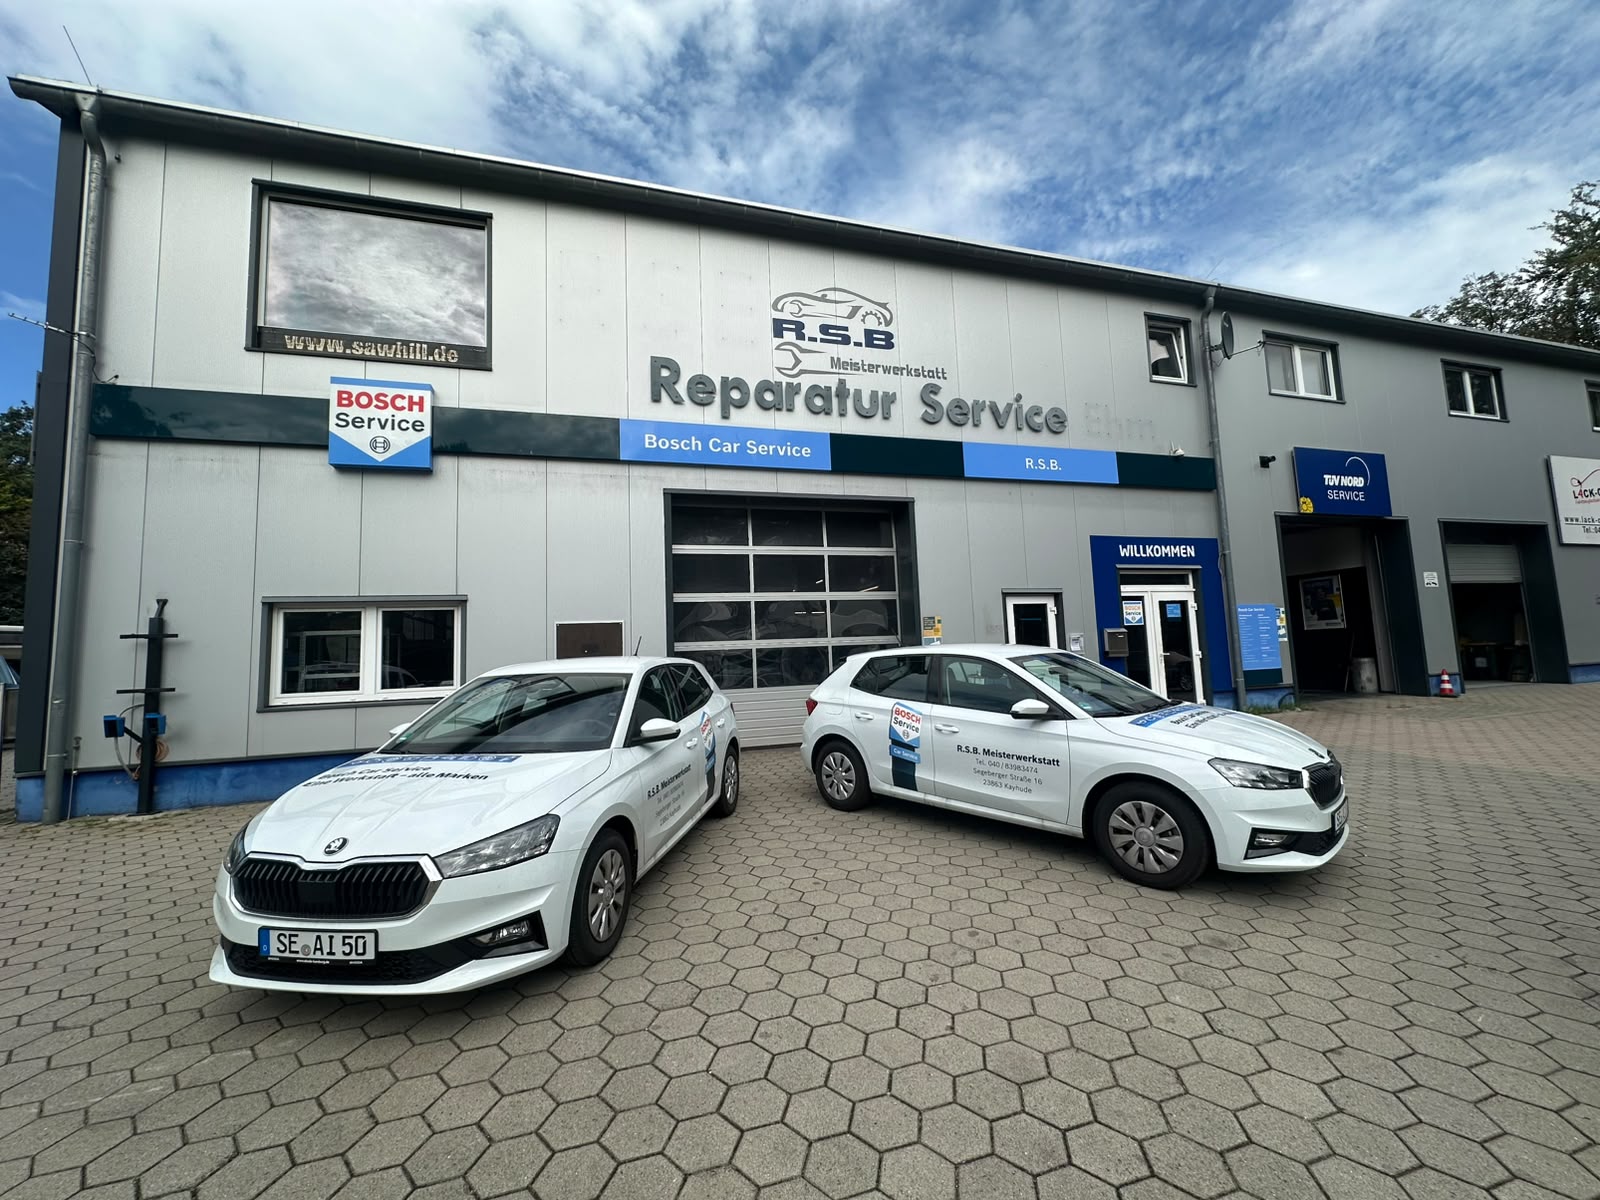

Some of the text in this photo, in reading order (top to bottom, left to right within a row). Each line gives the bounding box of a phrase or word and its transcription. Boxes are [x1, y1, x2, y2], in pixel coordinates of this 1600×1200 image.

[772, 317, 895, 350] R.S.B
[284, 335, 459, 363] www.sawhill.de
[830, 356, 948, 381] Meisterwerkstatt
[336, 390, 425, 412] BOSCH
[650, 355, 897, 419] Reparatur
[920, 382, 1069, 434] Service
[335, 412, 425, 432] Service
[644, 433, 812, 457] Bosch Car Service
[1025, 457, 1062, 471] R.S.B.
[1341, 475, 1364, 487] NORD
[1327, 489, 1366, 501] SERVICE
[1119, 544, 1196, 557] WILLKOMMEN
[893, 716, 920, 734] Service
[894, 706, 921, 725] BOSCH
[956, 744, 1061, 767] R.S.B. Meisterwerkstatt
[976, 758, 986, 766] Tel.
[988, 760, 1001, 769] 040
[436, 772, 489, 780] Marken
[973, 767, 1043, 786] Segeberger Straße 16
[1004, 783, 1033, 794] Kayhude
[276, 932, 367, 957] SE AI 50
